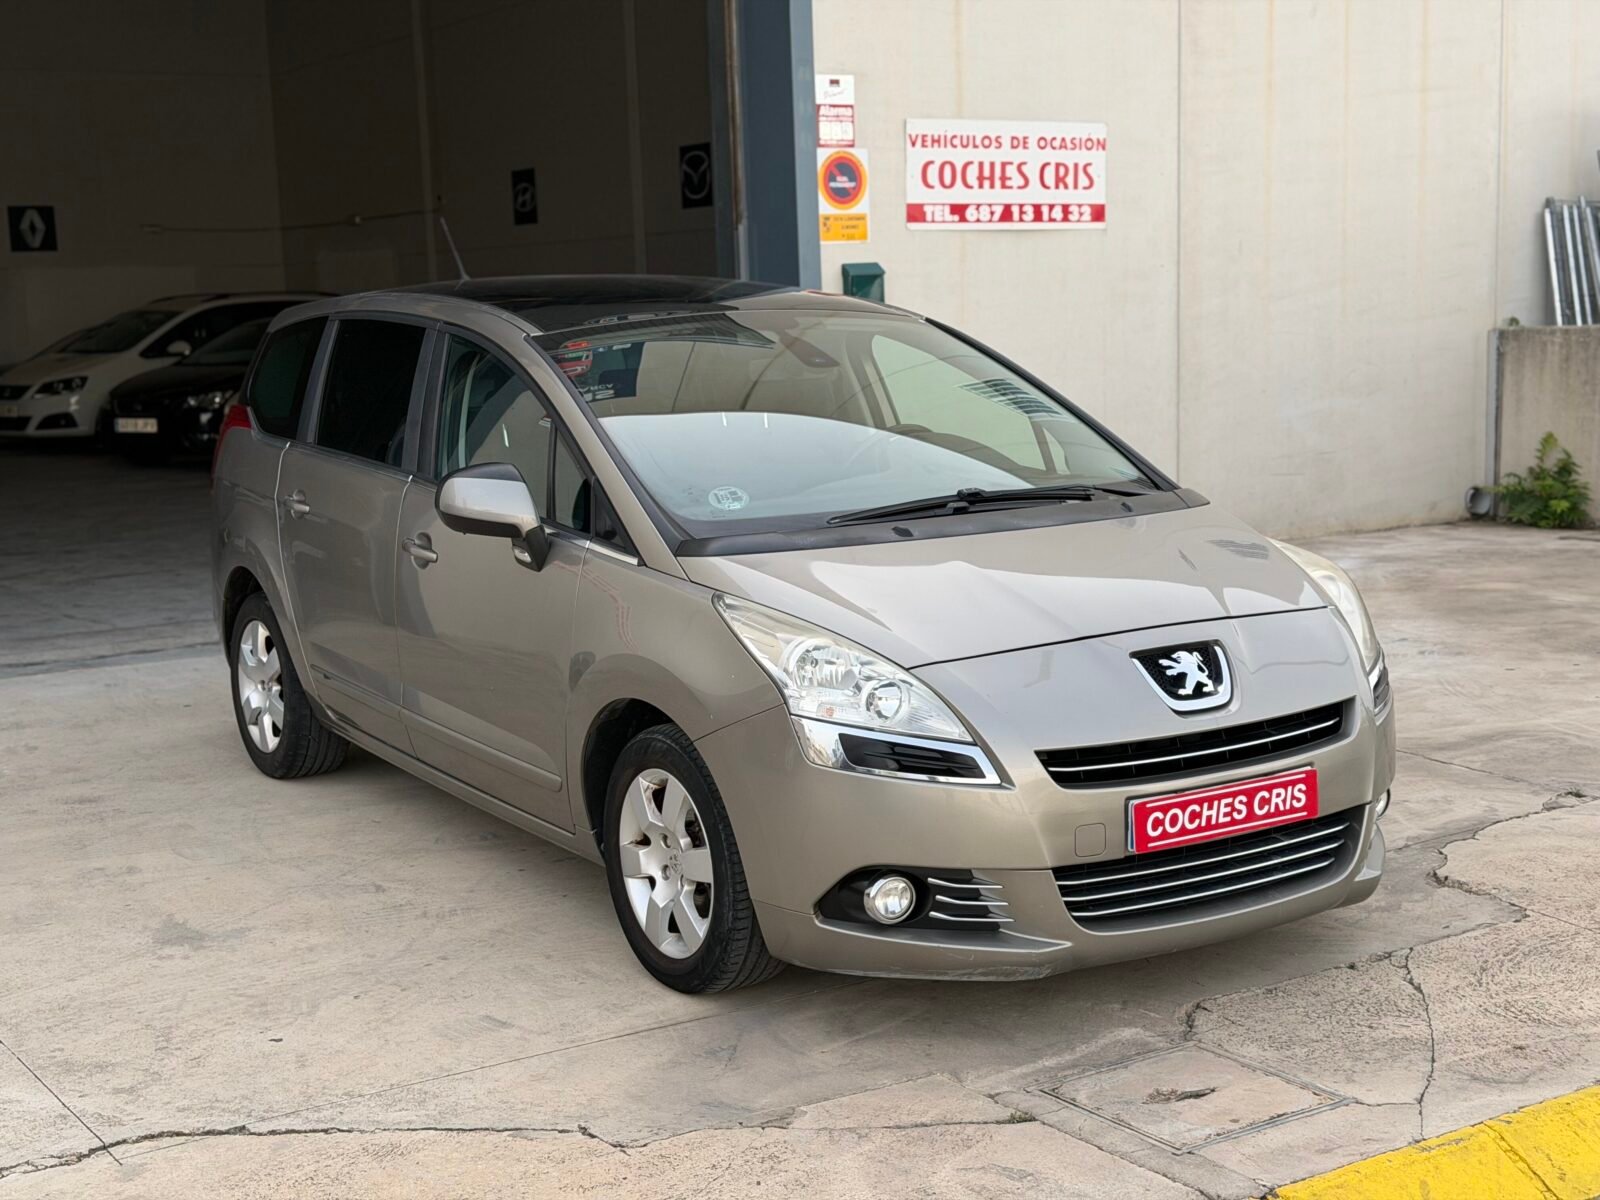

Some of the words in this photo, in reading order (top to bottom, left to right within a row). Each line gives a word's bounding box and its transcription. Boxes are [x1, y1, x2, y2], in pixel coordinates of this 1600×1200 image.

[908, 131, 1003, 150] VEHÍCULOS
[1010, 136, 1030, 150] DE
[1037, 133, 1107, 151] OCASIÓN
[921, 160, 1030, 190] COCHES
[1039, 162, 1095, 190] CRIS
[923, 204, 960, 222] TEL.
[965, 204, 1005, 222] 687
[1010, 204, 1035, 222] 13
[1041, 204, 1064, 222] 14
[1068, 204, 1092, 222] 32
[1146, 795, 1248, 837] COCHES
[1253, 783, 1307, 816] CRIS
